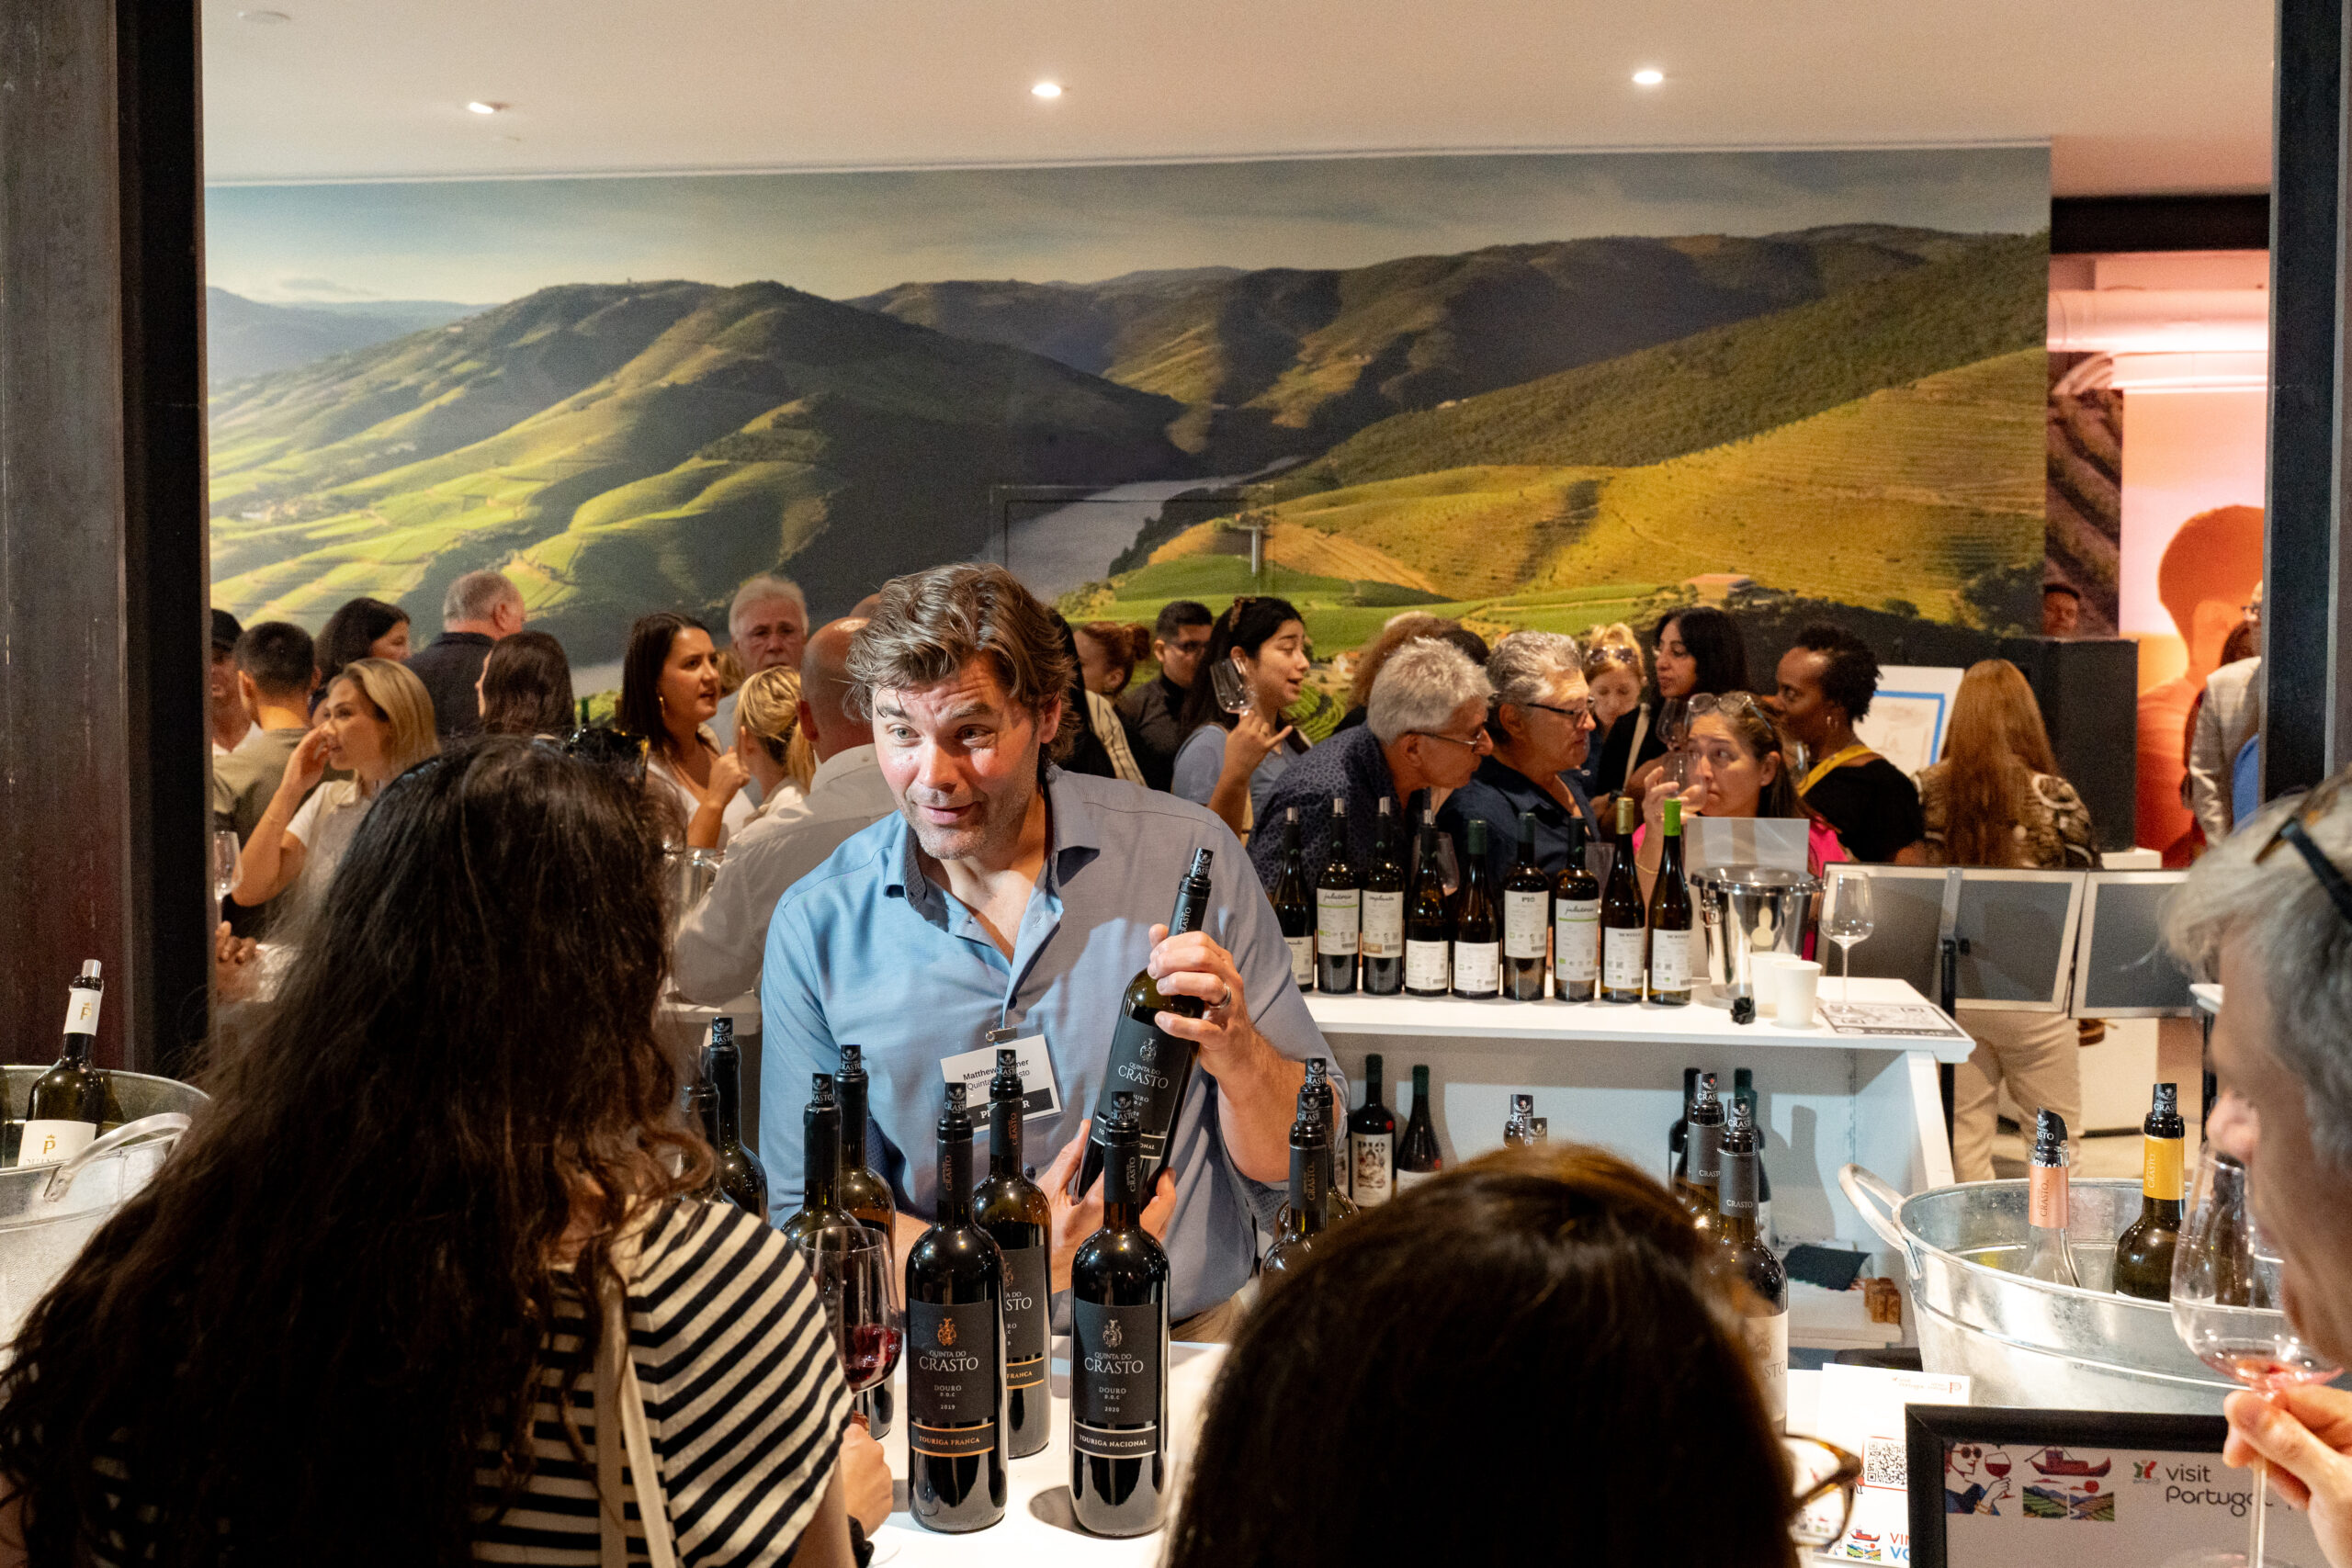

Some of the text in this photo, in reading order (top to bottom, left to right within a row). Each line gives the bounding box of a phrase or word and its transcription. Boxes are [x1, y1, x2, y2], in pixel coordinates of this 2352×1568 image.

[1118, 1065, 1169, 1089] CRASTO
[1129, 1062, 1161, 1076] QUINTA DO
[2147, 1154, 2156, 1189] CRASTO
[1307, 1165, 1316, 1201] CRASTO
[1726, 1199, 1753, 1209] CRASTO
[2040, 1181, 2049, 1217] CRASTO
[1006, 1297, 1032, 1311] STO
[929, 1349, 955, 1359] QUINTA
[1094, 1351, 1119, 1360] QUINTA
[919, 1356, 978, 1372] CRASTO
[1084, 1357, 1144, 1374] CRASTO
[1764, 1359, 1785, 1379] STO
[1099, 1386, 1126, 1394] DOURO
[919, 1436, 949, 1446] TOURIGA
[1079, 1434, 1147, 1448] TOURIGA NACIONAL
[2165, 1463, 2211, 1483] visit
[2165, 1484, 2274, 1517] Portug
